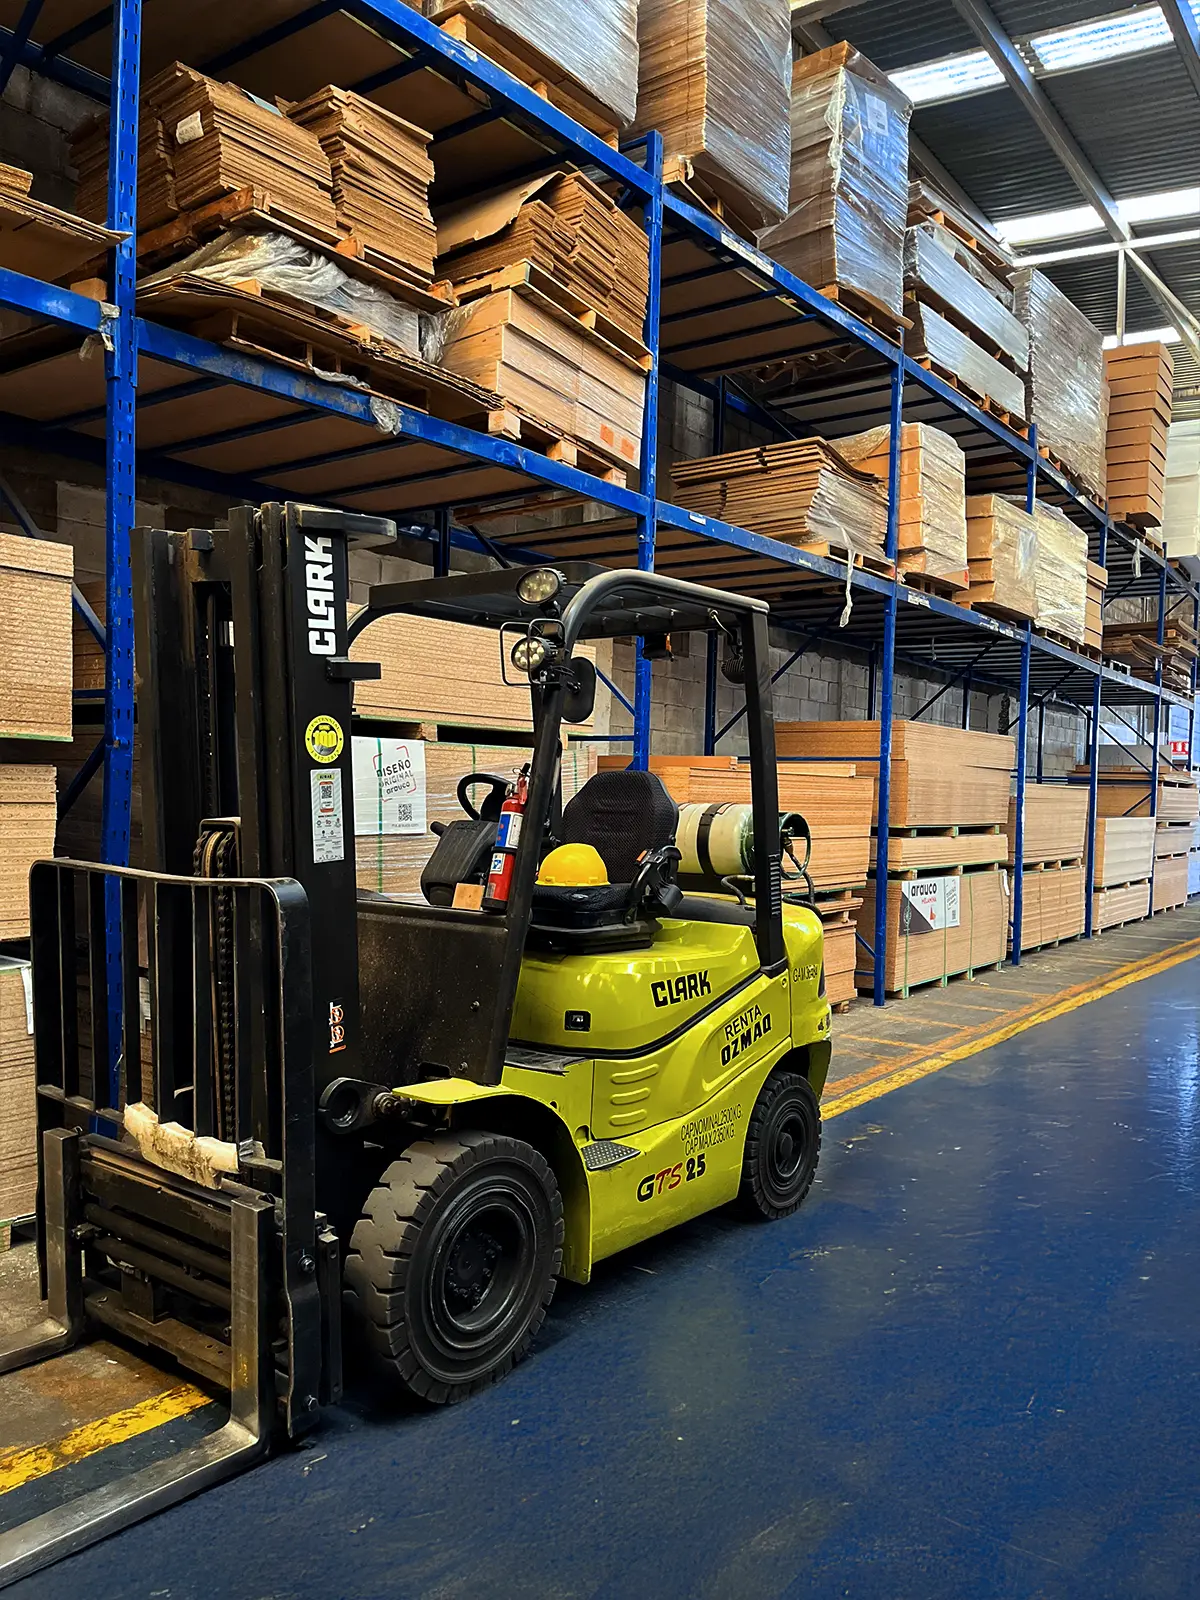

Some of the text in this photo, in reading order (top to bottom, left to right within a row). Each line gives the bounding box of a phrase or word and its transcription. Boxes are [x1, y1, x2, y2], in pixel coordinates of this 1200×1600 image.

[304, 535, 336, 655] CLARK
[386, 781, 411, 795] arauco
[911, 883, 937, 897] arauco
[651, 970, 712, 1008] CLARK
[721, 1014, 772, 1066] OZMAQ
[724, 1004, 762, 1040] RENTA
[637, 1153, 706, 1202] GTS 25
